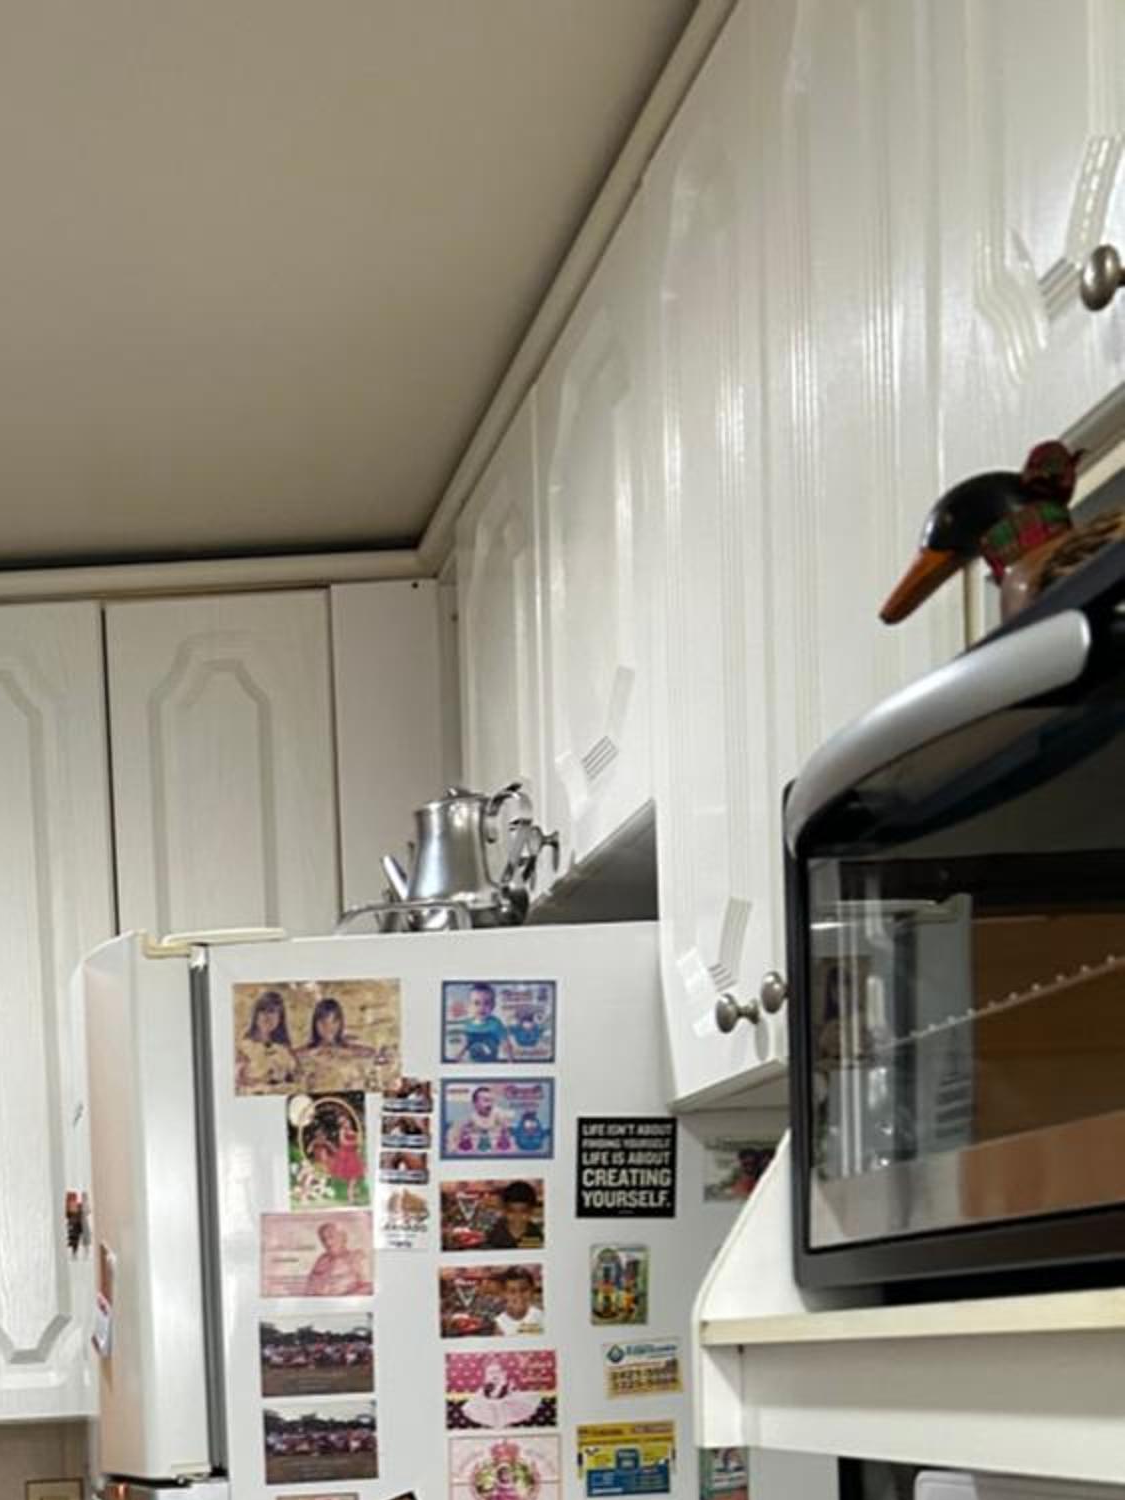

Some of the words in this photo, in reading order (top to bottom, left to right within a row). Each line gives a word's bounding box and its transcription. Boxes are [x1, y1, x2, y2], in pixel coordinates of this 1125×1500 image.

[581, 1123, 605, 1136] LIFE
[636, 1123, 672, 1136] ABOUT
[581, 1151, 609, 1166] LIFE
[611, 1151, 625, 1166] IS
[627, 1151, 671, 1165] ABOUT
[582, 1167, 672, 1187] CREATING
[581, 1189, 672, 1208] YOURSELF.
